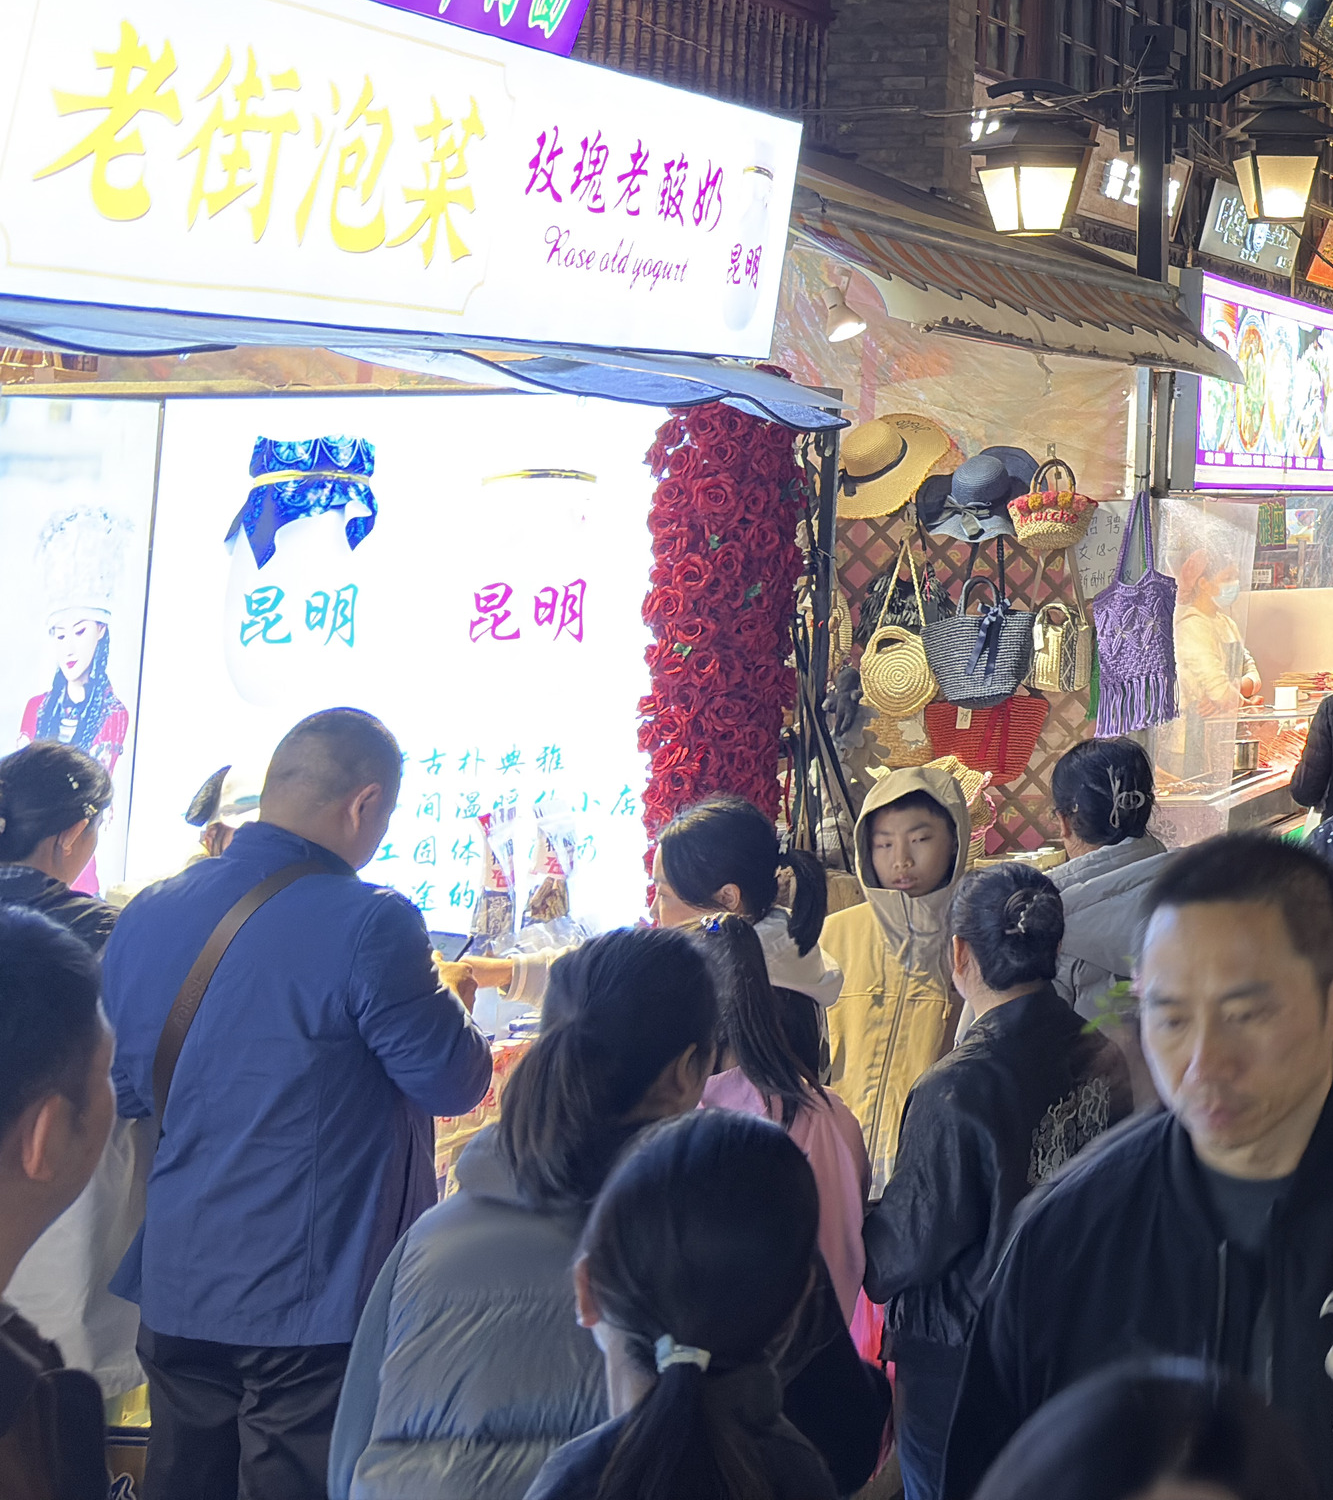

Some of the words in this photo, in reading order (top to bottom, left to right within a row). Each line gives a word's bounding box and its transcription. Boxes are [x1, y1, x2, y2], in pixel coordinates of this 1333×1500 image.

[33, 18, 488, 271] 老街泡菜
[524, 124, 724, 233] 玫瑰老酸奶
[544, 225, 597, 271] Rose
[599, 238, 635, 274] old
[629, 257, 690, 292] yogurt
[726, 243, 763, 290] 昆明
[238, 582, 360, 648] 昆明
[468, 578, 588, 644] 昆明
[400, 743, 565, 778] 古朴典雅
[396, 784, 636, 823] 间温暖小店
[376, 833, 598, 866] 工固体奶
